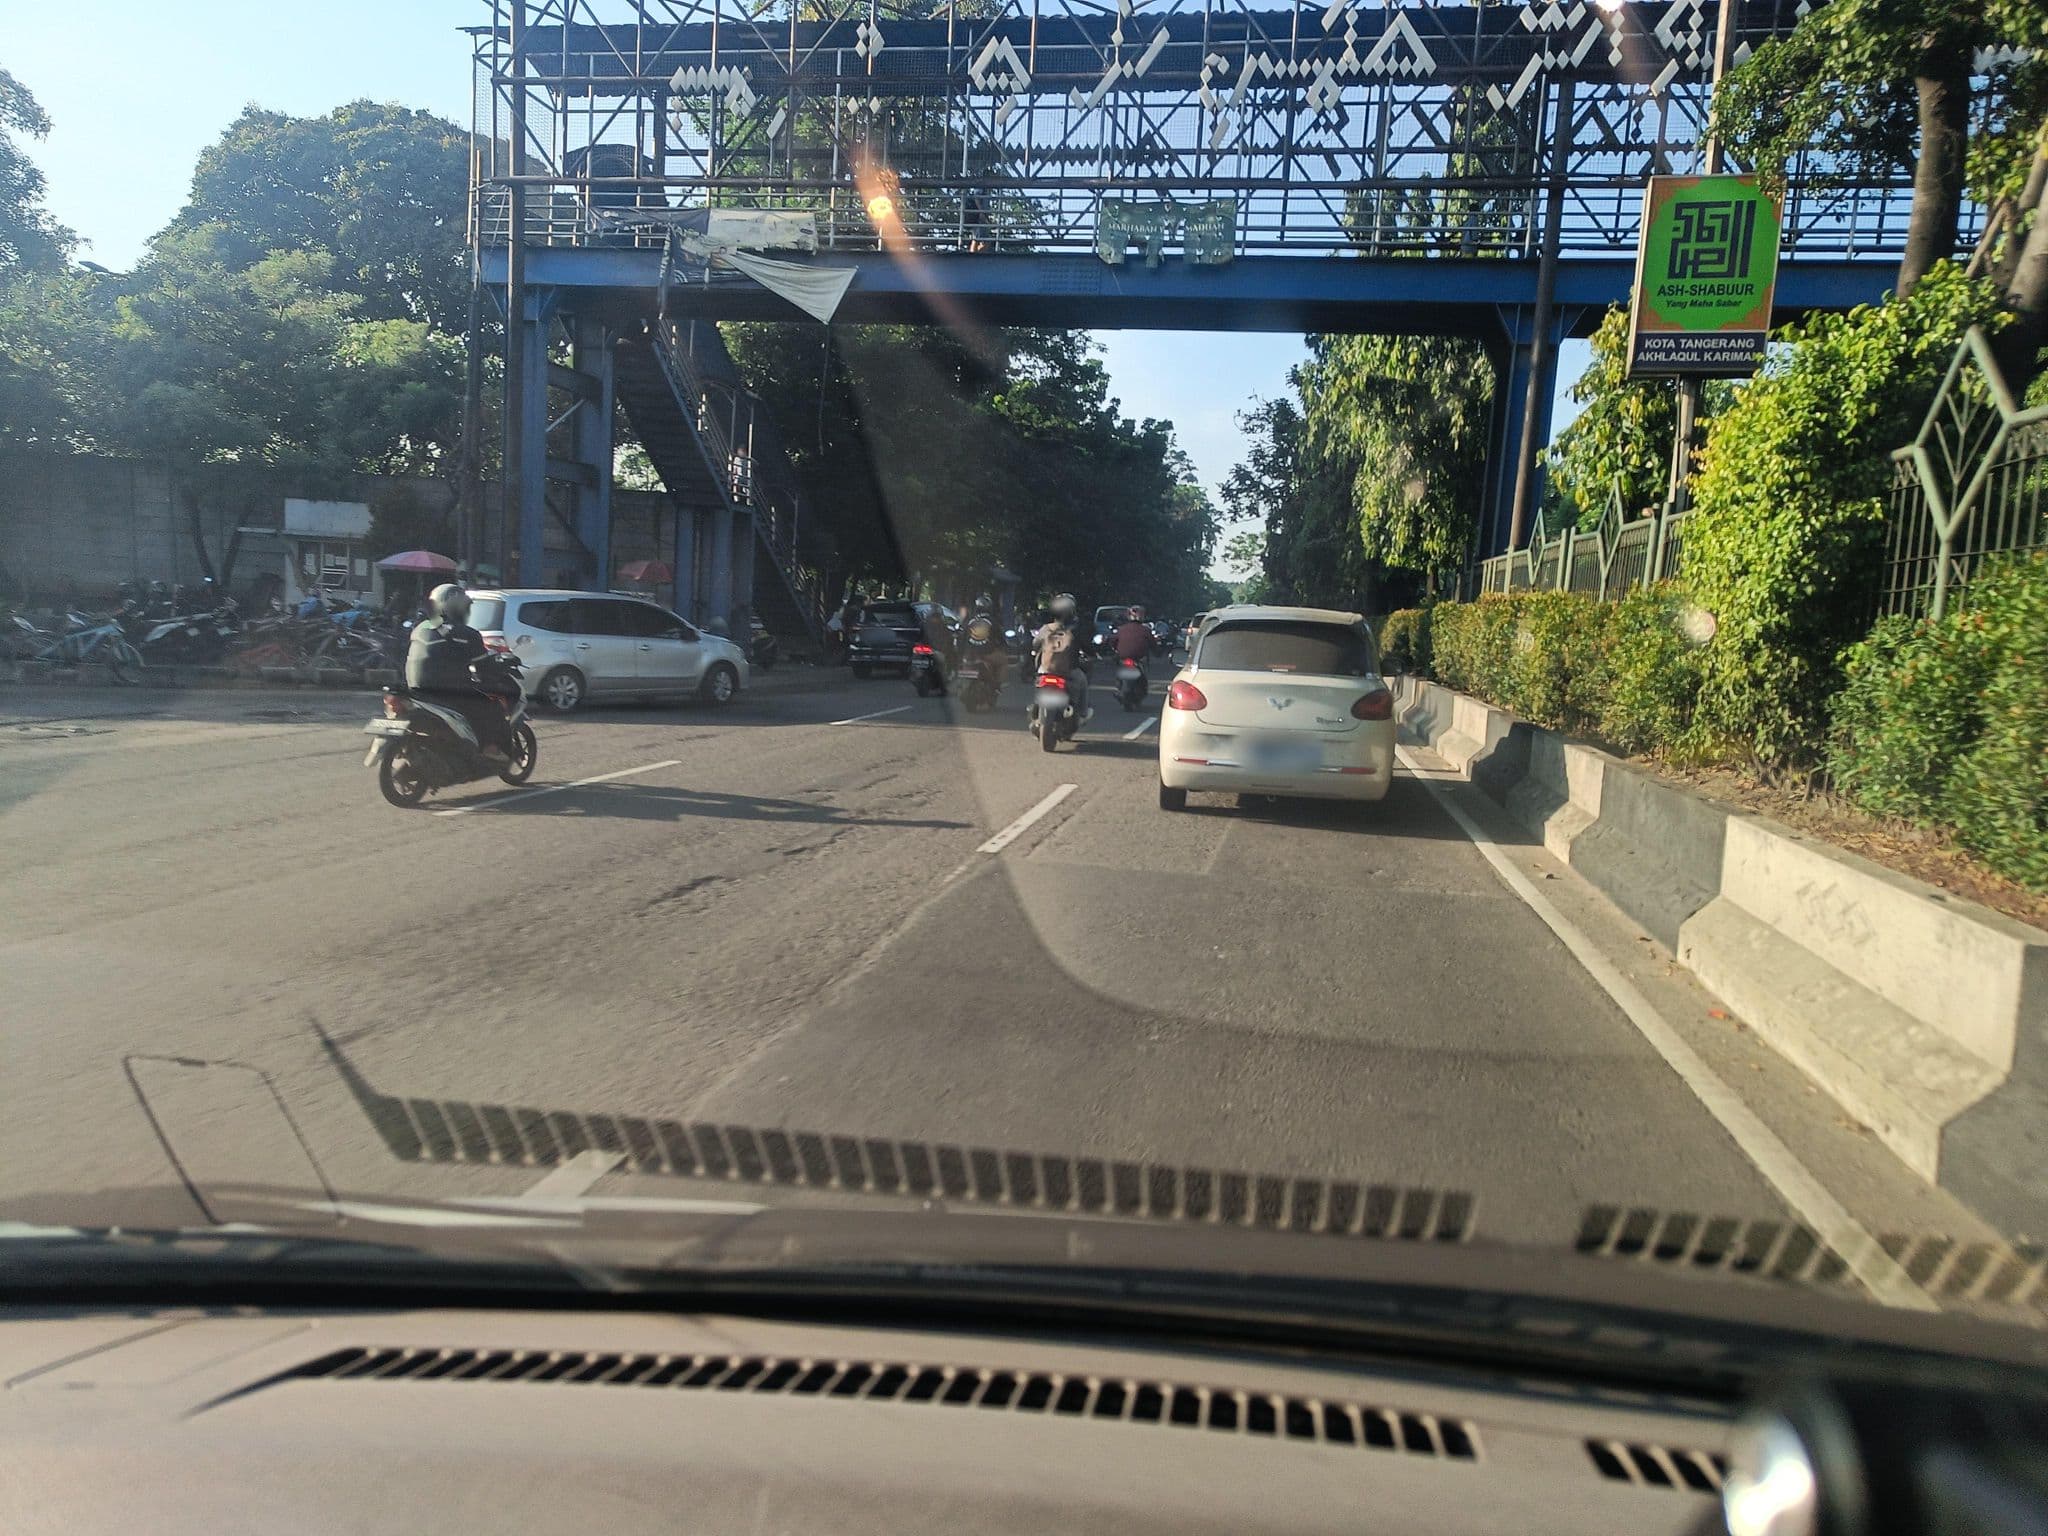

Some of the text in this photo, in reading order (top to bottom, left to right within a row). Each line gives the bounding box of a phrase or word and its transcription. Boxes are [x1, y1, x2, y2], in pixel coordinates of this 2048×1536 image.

[1657, 283, 1754, 297] ASH-SHABUUR
[1666, 300, 1688, 309] Yang
[1689, 299, 1713, 308] Maha
[1644, 338, 1755, 349] KOTA TANGERANG
[1637, 351, 1700, 362] AKHLAQUL
